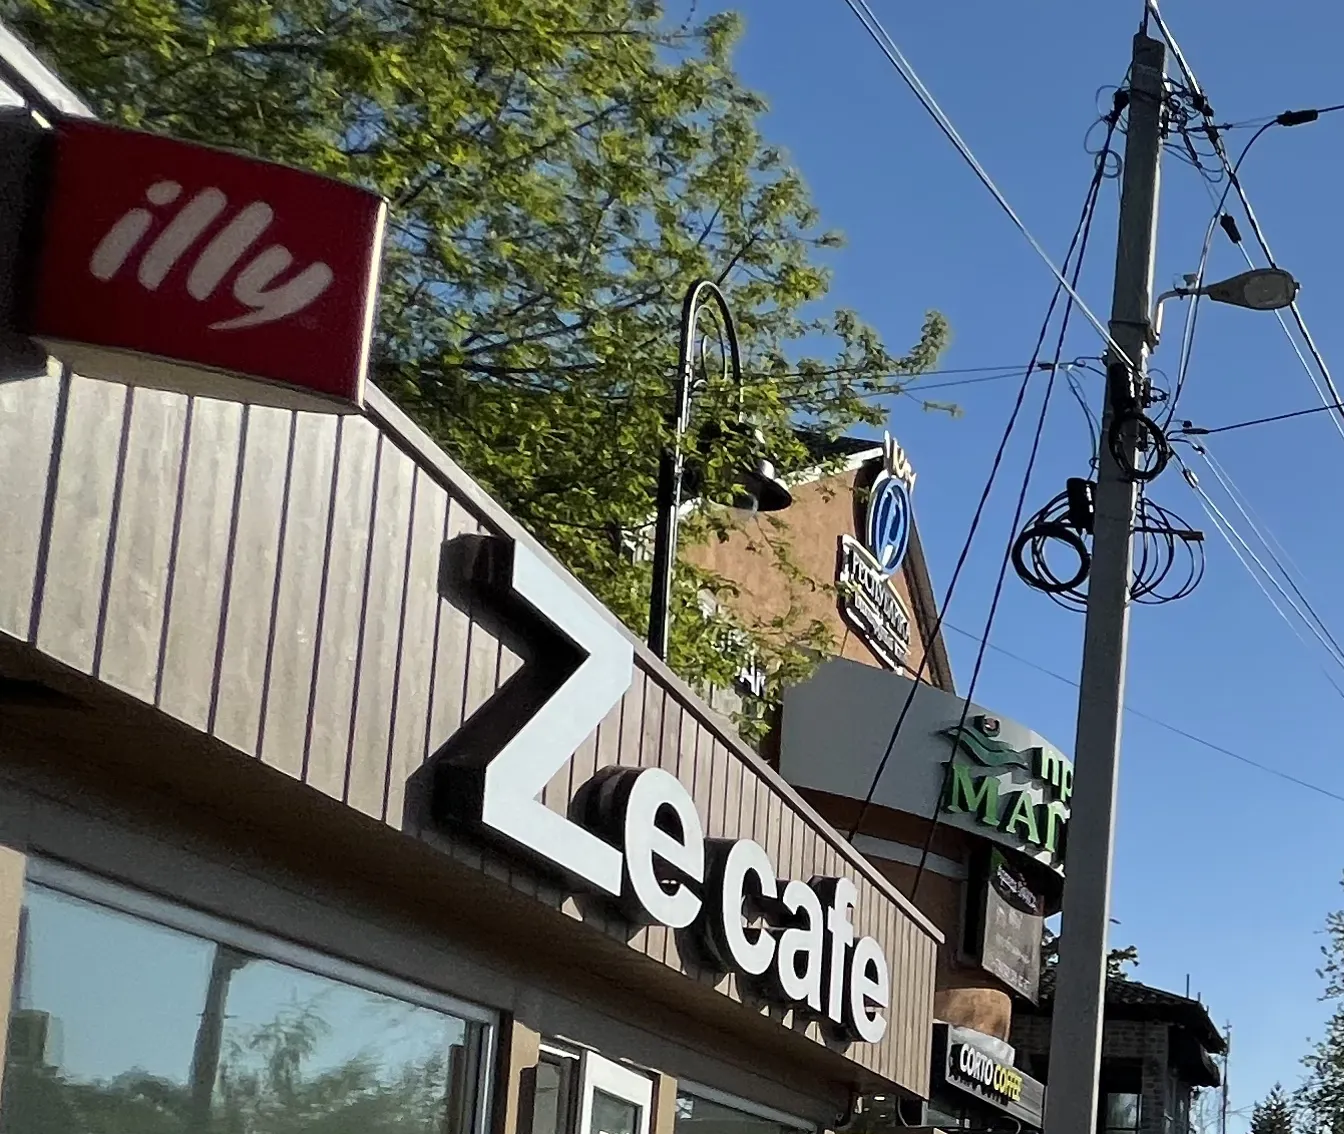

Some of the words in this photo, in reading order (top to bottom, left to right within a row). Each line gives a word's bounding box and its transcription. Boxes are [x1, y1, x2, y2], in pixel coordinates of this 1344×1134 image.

[89, 180, 333, 331] illy
[481, 537, 705, 929] Ze
[722, 837, 890, 1045] cafe
[960, 1043, 995, 1086] CORTO
